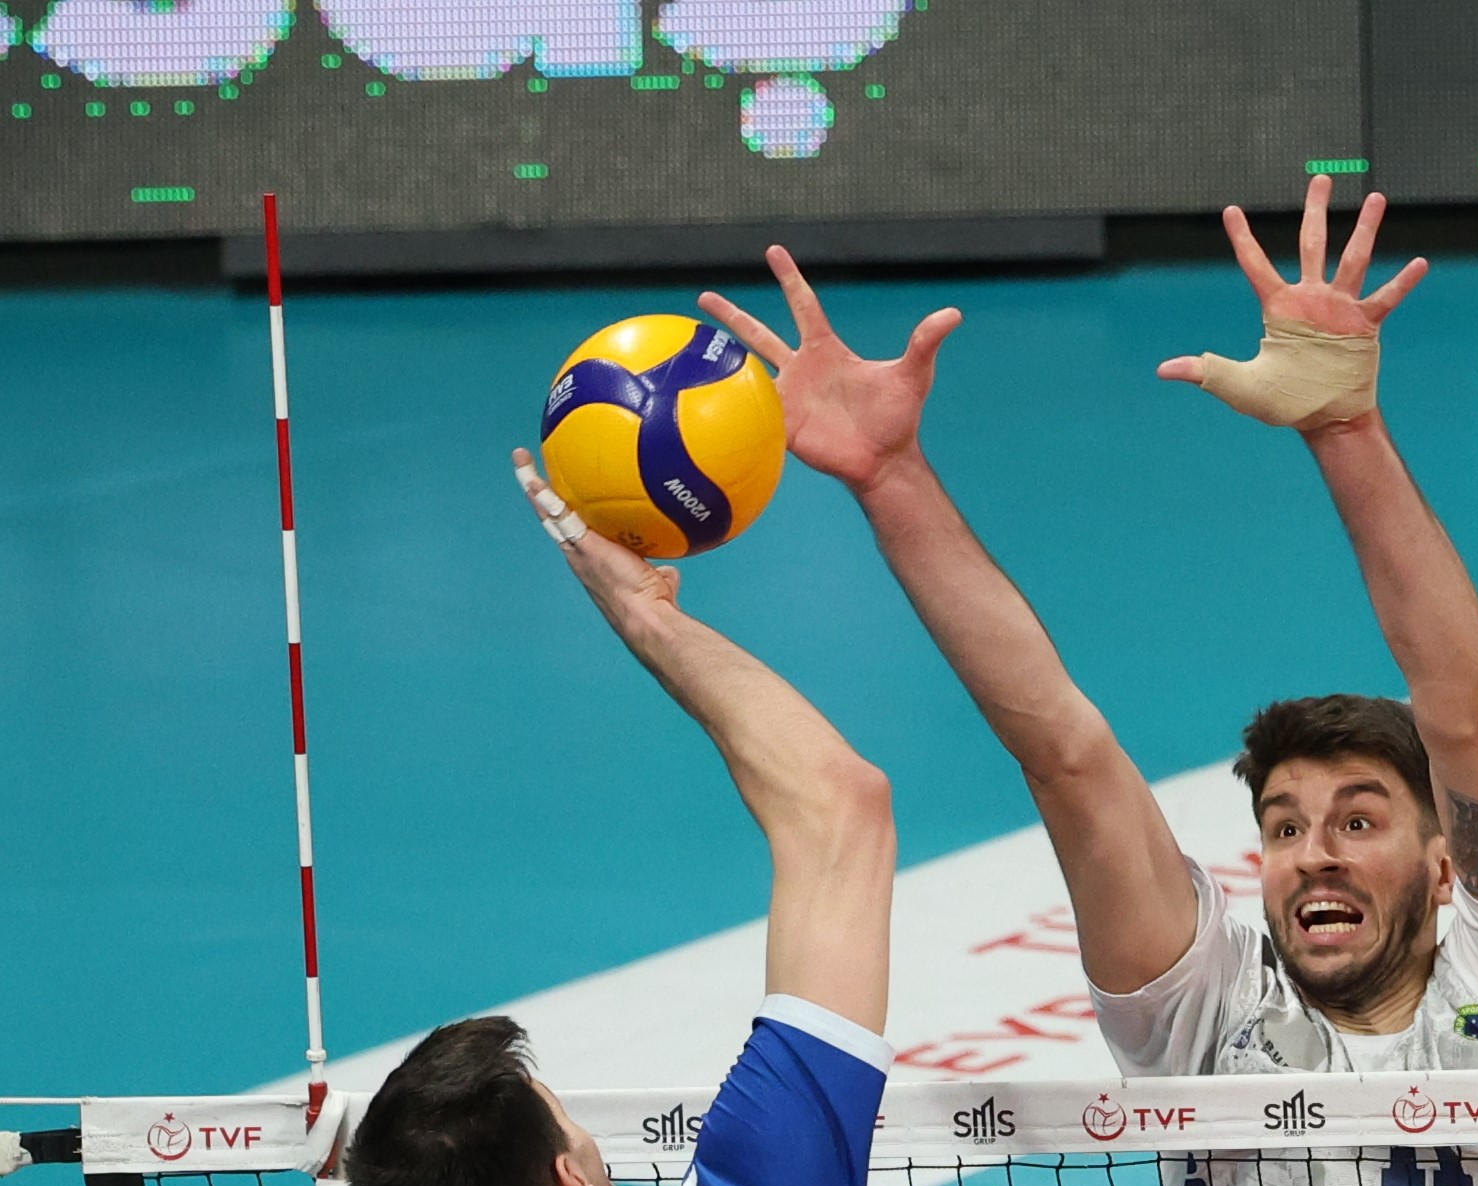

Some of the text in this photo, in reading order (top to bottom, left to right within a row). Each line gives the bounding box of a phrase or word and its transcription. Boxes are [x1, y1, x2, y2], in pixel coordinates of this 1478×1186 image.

[663, 478, 712, 522] V200W
[643, 1103, 703, 1144] SMS
[953, 1097, 1016, 1139] SMS
[1134, 1108, 1196, 1132] TVF
[1264, 1089, 1326, 1131] SMS
[199, 1127, 262, 1150] TVF
[662, 1143, 685, 1152] GRUP
[974, 1138, 996, 1146] GRUP
